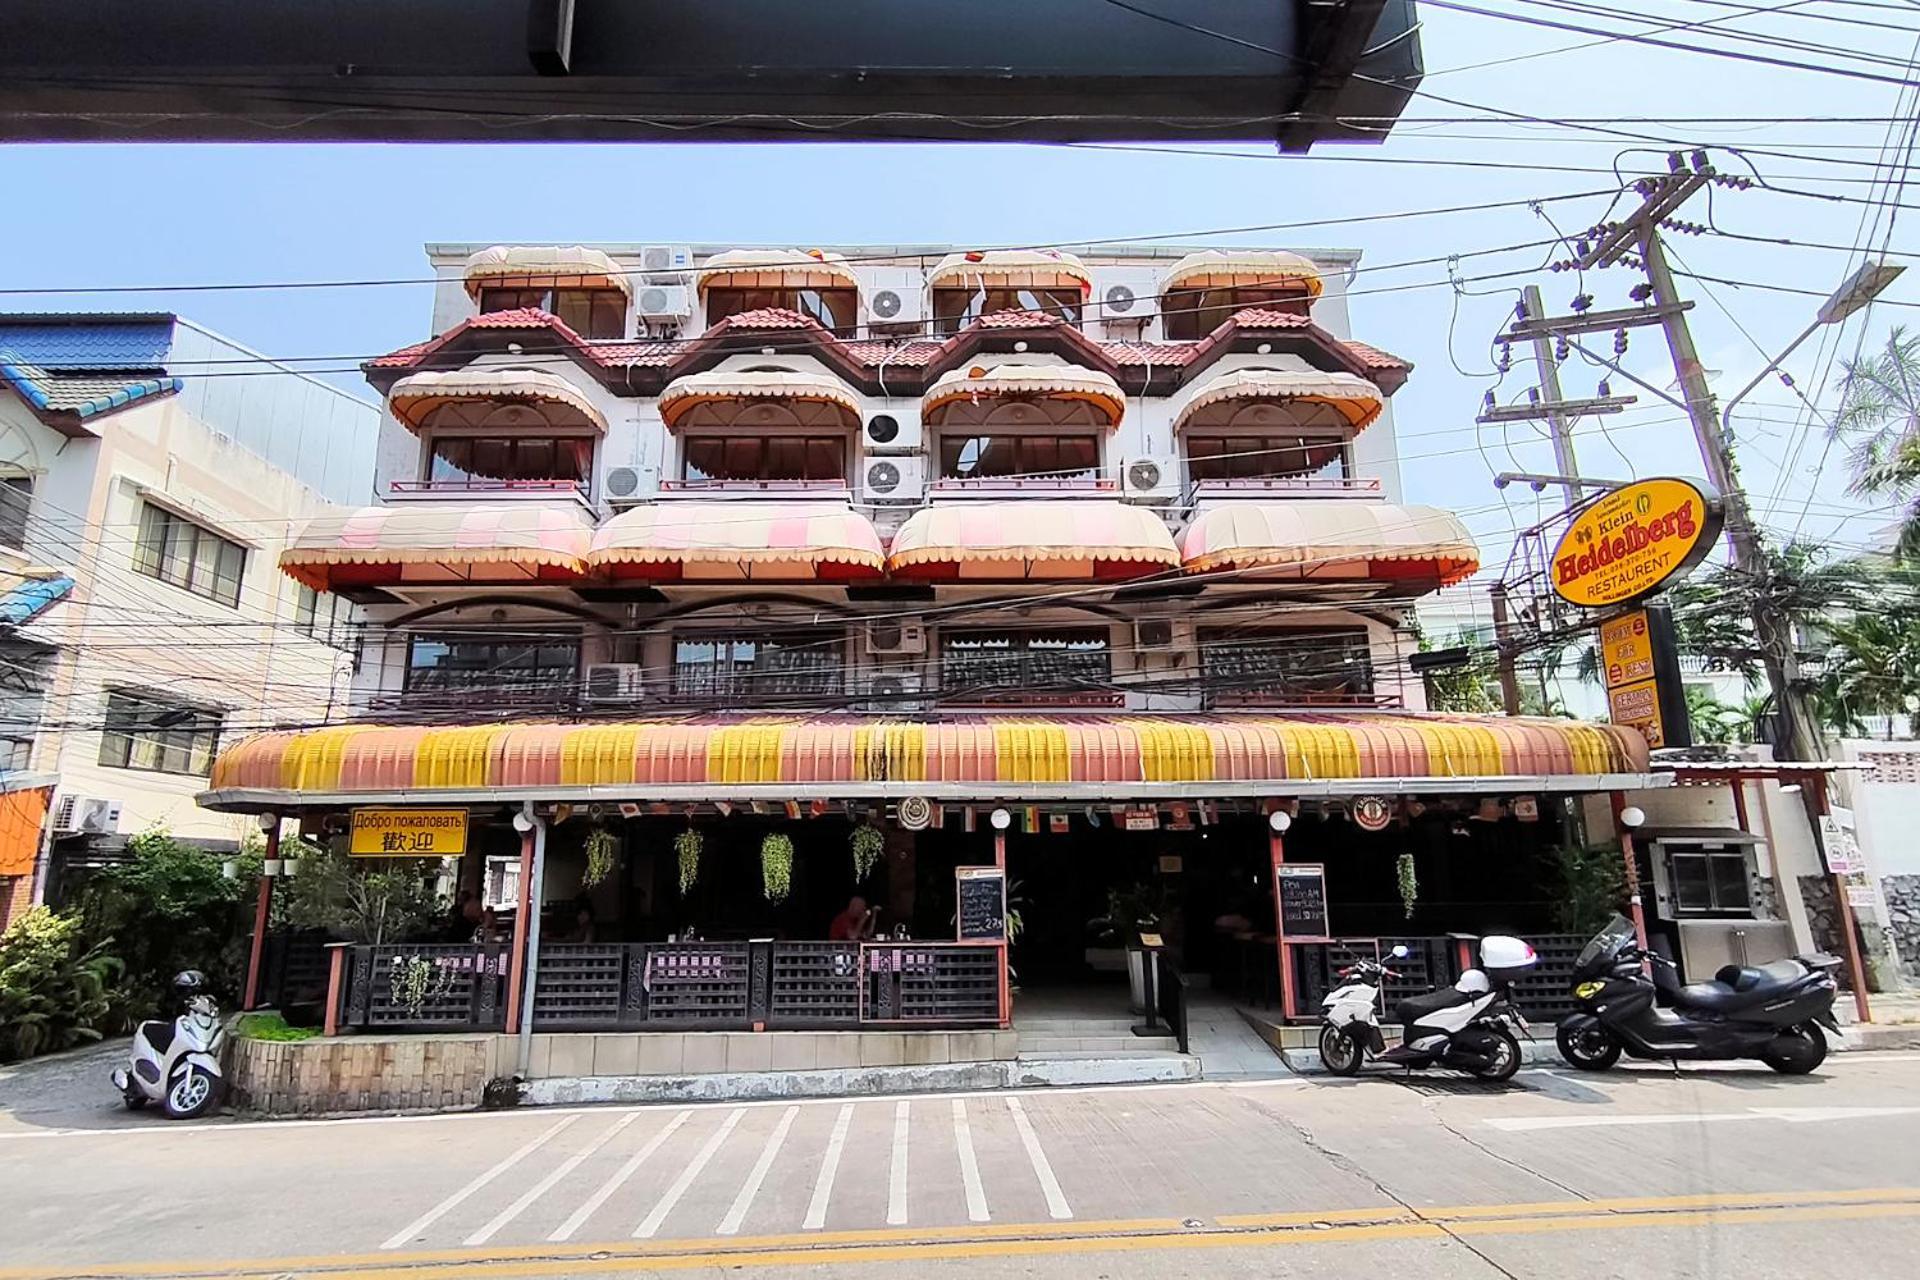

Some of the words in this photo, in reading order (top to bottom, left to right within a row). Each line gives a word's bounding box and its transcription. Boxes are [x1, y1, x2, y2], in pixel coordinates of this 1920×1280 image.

[1598, 511, 1634, 536] Klein
[1556, 499, 1697, 586] Heidelberg
[1587, 552, 1672, 599] RESTAURENT
[354, 813, 392, 831] Добро
[393, 812, 467, 829] пожаловать!
[381, 831, 434, 852] 歡迎
